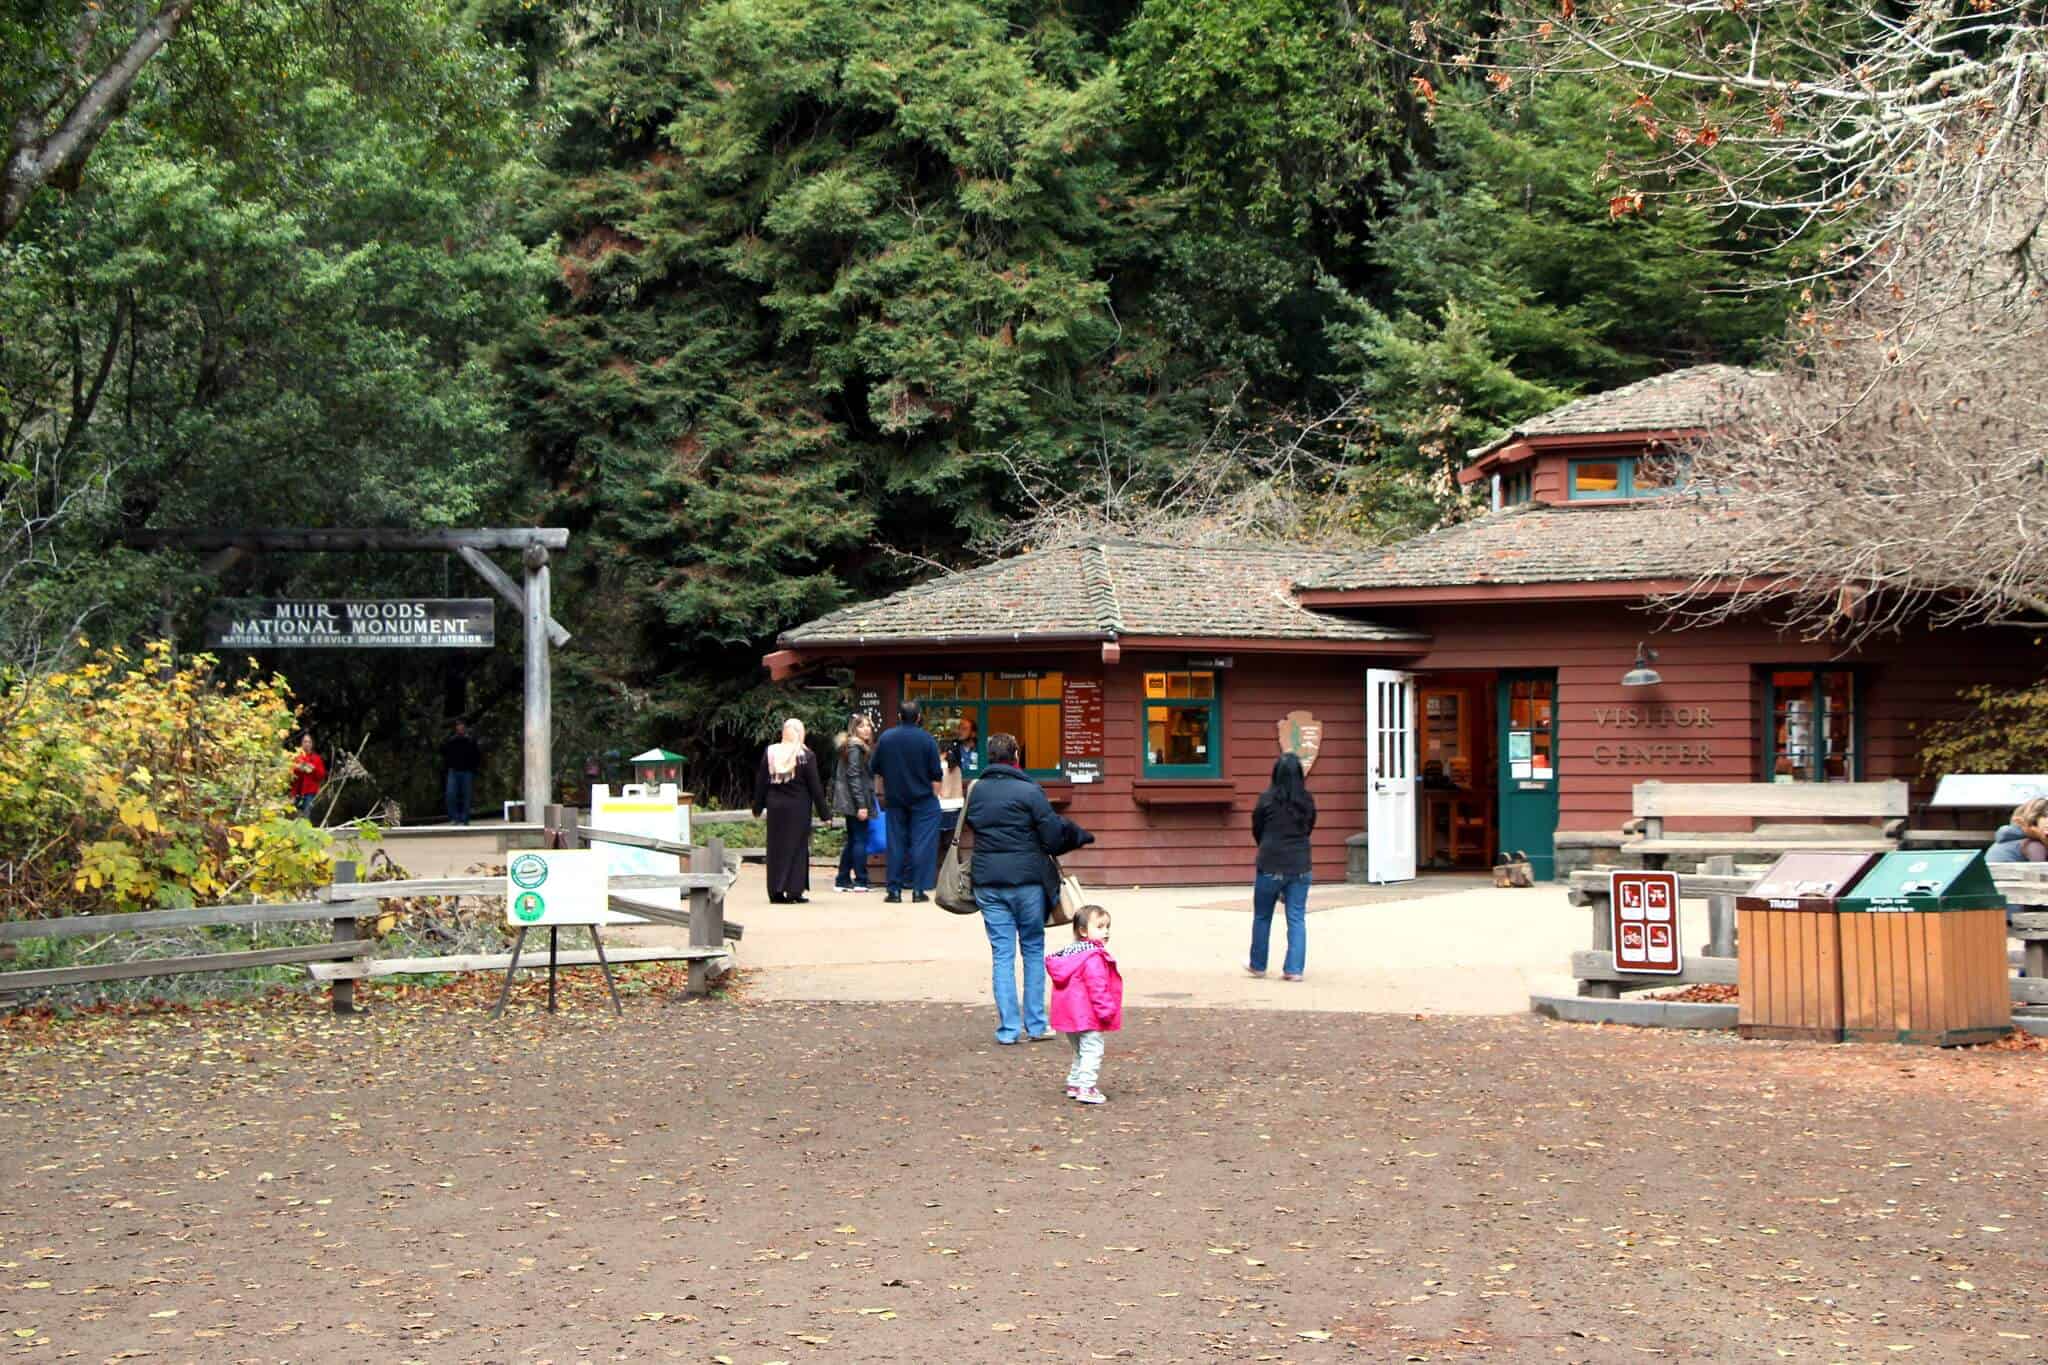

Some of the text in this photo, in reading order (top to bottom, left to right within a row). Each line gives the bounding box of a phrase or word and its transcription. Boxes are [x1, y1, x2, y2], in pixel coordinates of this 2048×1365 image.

[276, 603, 426, 619] MUIR WOODS
[231, 619, 469, 634] NATIONAL MONUMENT
[221, 634, 482, 644] NATIONAL PARK SERVICE DEPARTMENT OF INTERIOR
[1593, 706, 1713, 728] VISITOR
[1593, 743, 1713, 765] CENTER
[1768, 899, 1799, 909] TRASH
